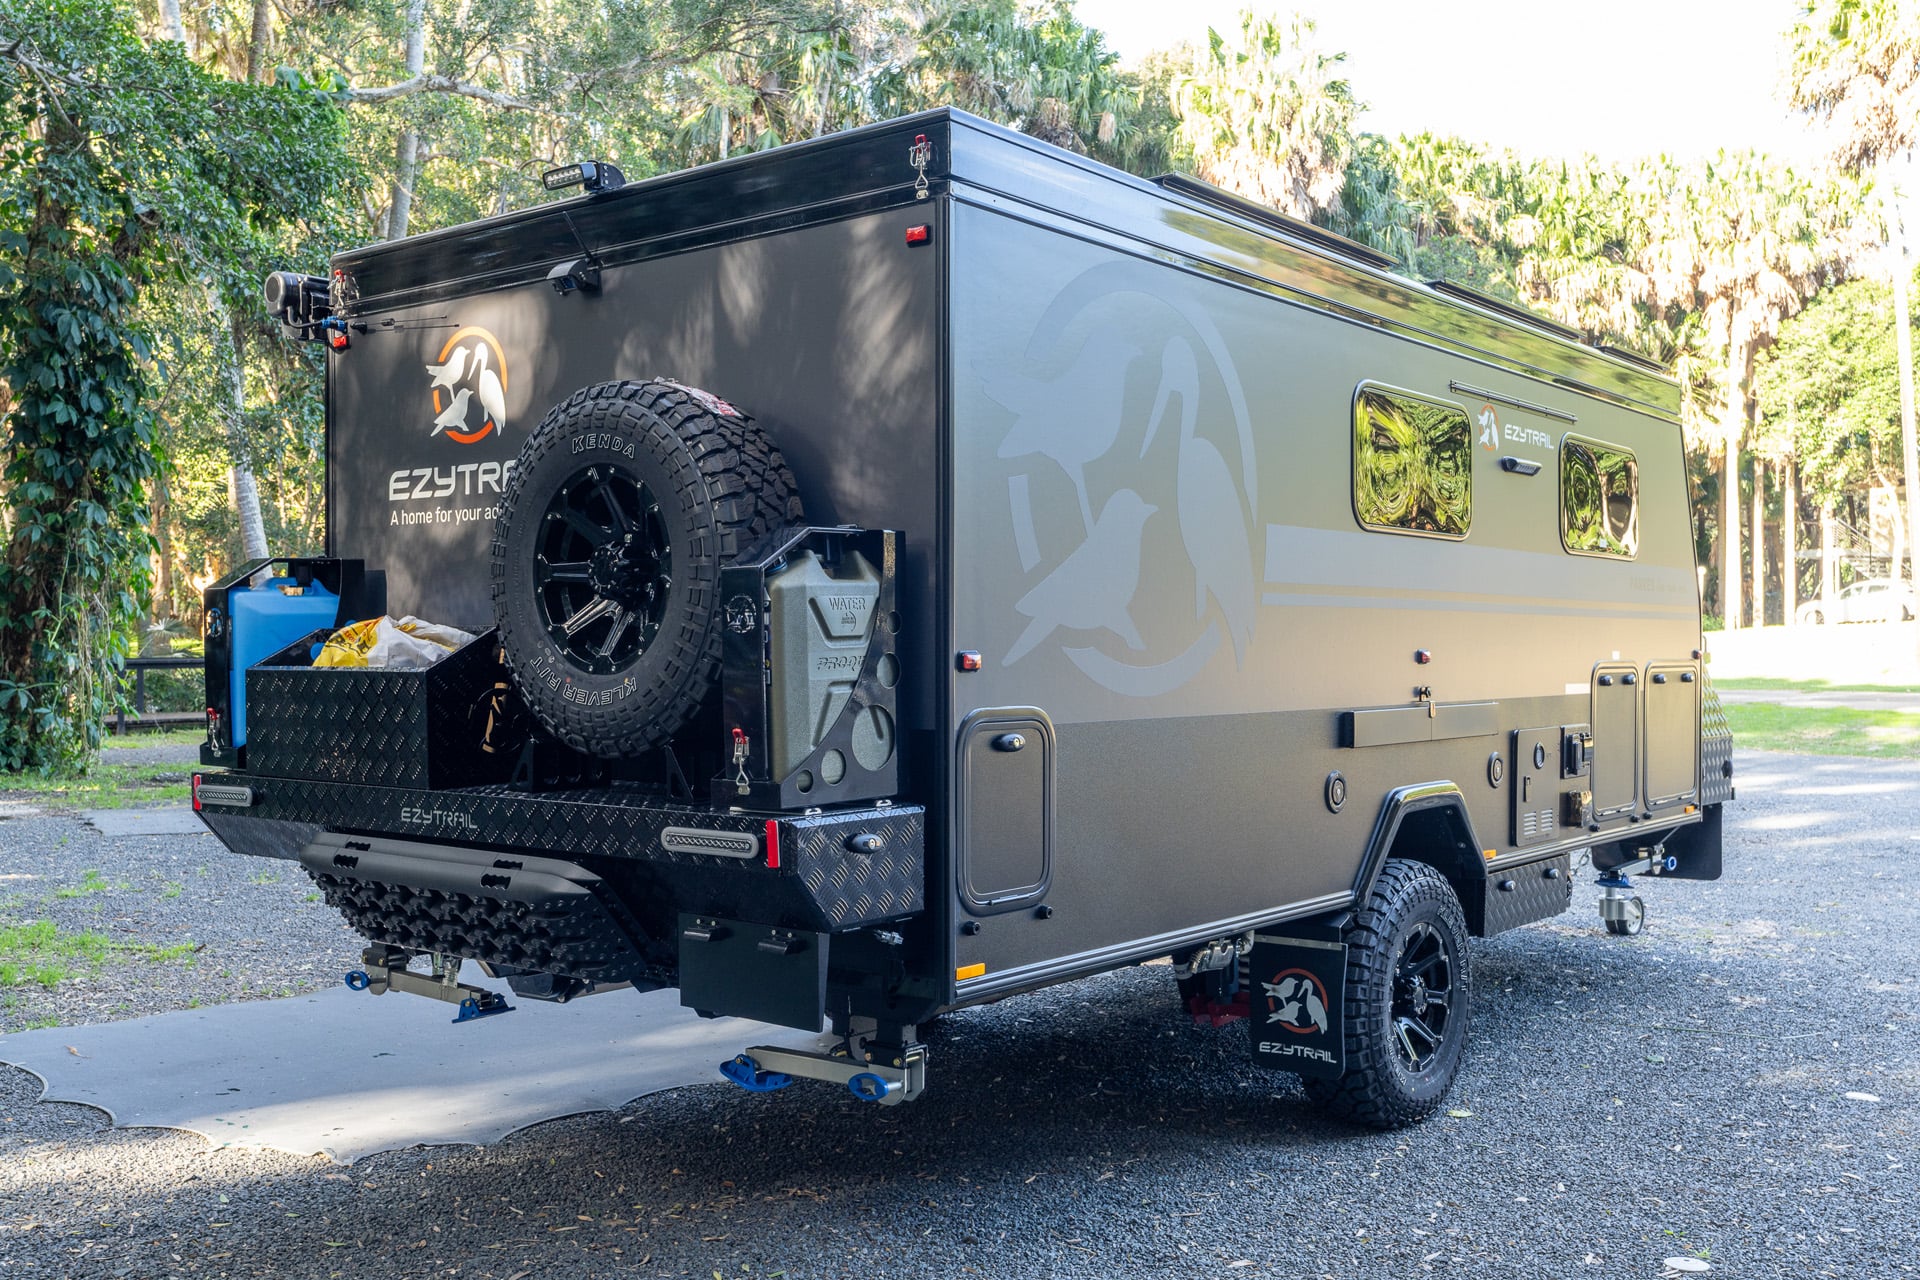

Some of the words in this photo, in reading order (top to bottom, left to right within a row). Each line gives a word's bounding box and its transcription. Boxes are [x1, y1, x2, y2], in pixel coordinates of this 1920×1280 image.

[572, 433, 635, 459] KENDA
[1504, 424, 1555, 449] EZYTRAIL
[390, 510, 399, 526] A
[401, 509, 433, 525] home
[435, 506, 452, 523] for
[455, 508, 481, 526] your
[829, 597, 866, 610] WATER
[530, 656, 561, 691] R/T
[562, 677, 637, 706] KLEVER
[401, 807, 478, 829] EZYTRAIL
[1259, 1041, 1337, 1064] EZYTRAIL
